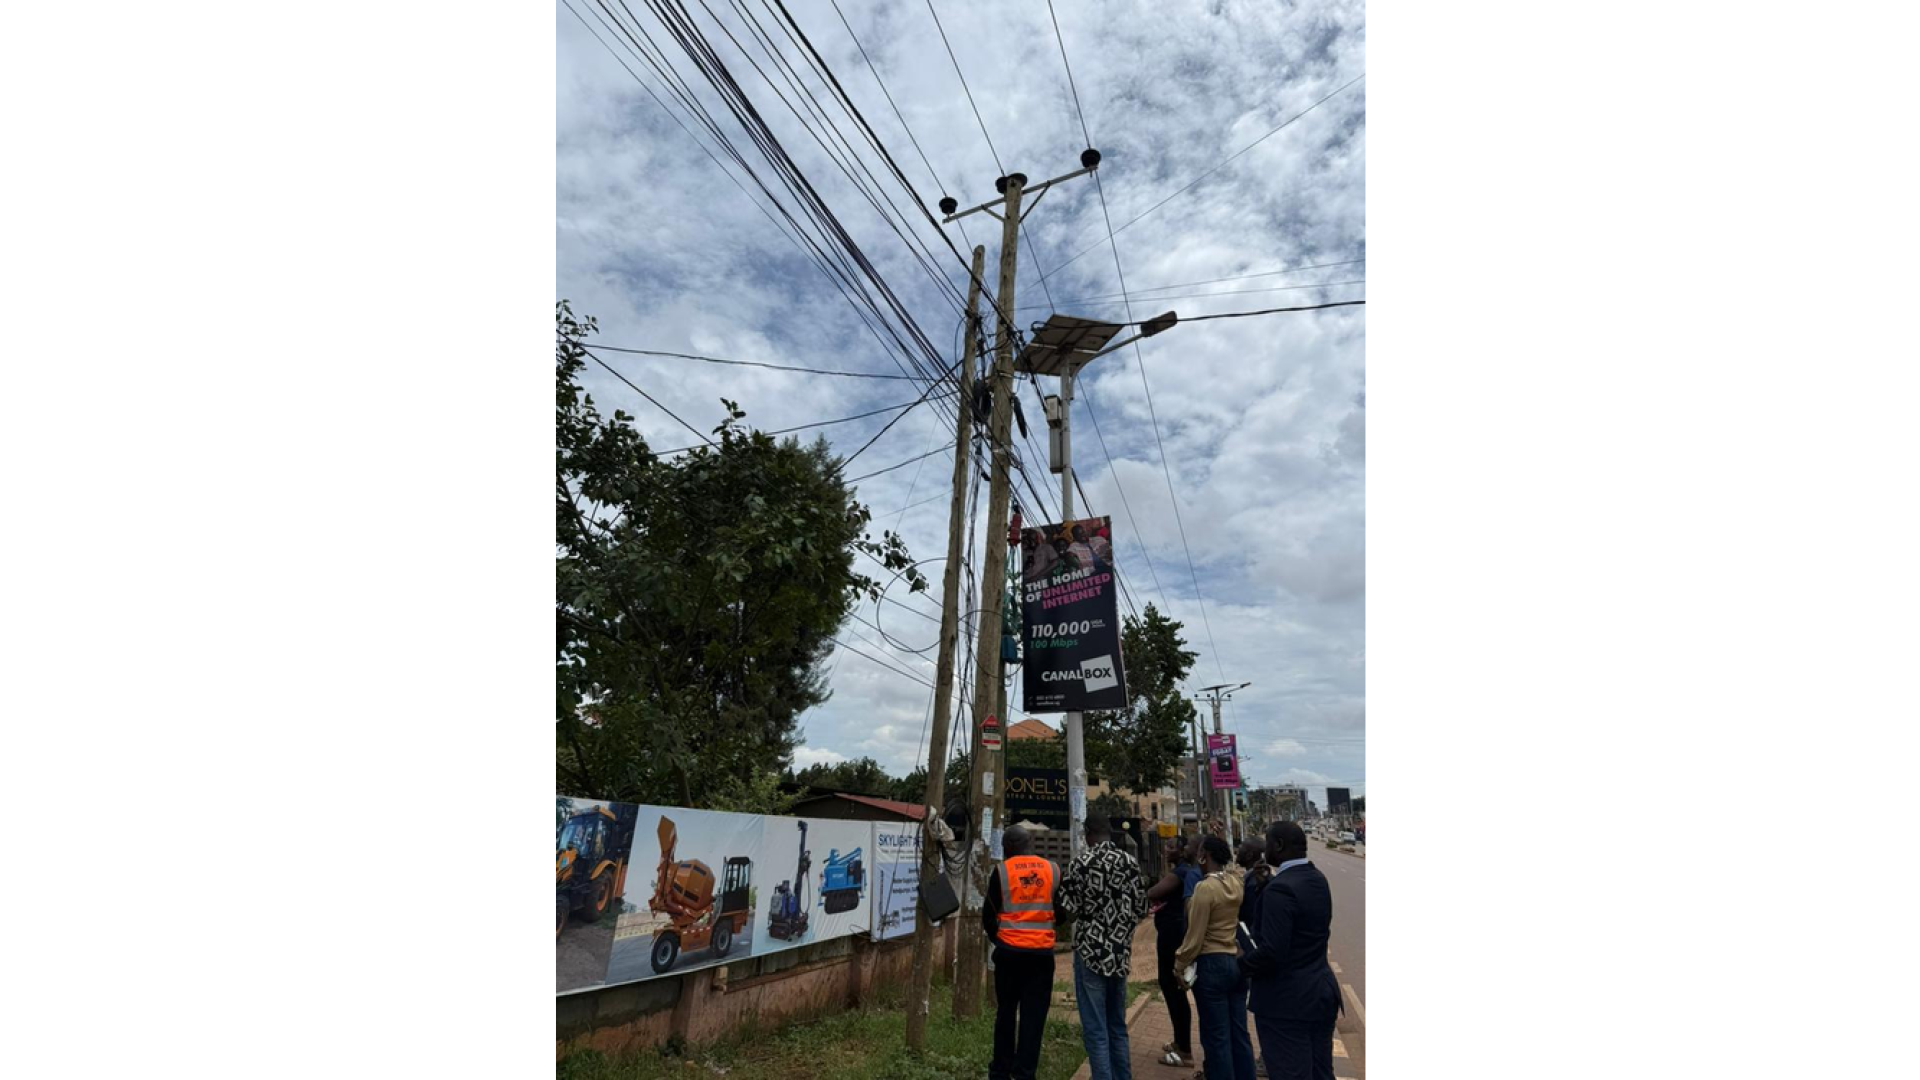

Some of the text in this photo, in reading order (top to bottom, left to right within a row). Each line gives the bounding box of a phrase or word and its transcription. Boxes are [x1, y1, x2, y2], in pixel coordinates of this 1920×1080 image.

[1026, 570, 1090, 592] THE HOME
[1026, 573, 1110, 603] OF UNLIMITED
[1042, 586, 1102, 610] INTERNET
[1031, 620, 1090, 638] 110,000
[1030, 638, 1079, 649] 100 Mbps
[878, 833, 913, 847] SKYLIGHT
